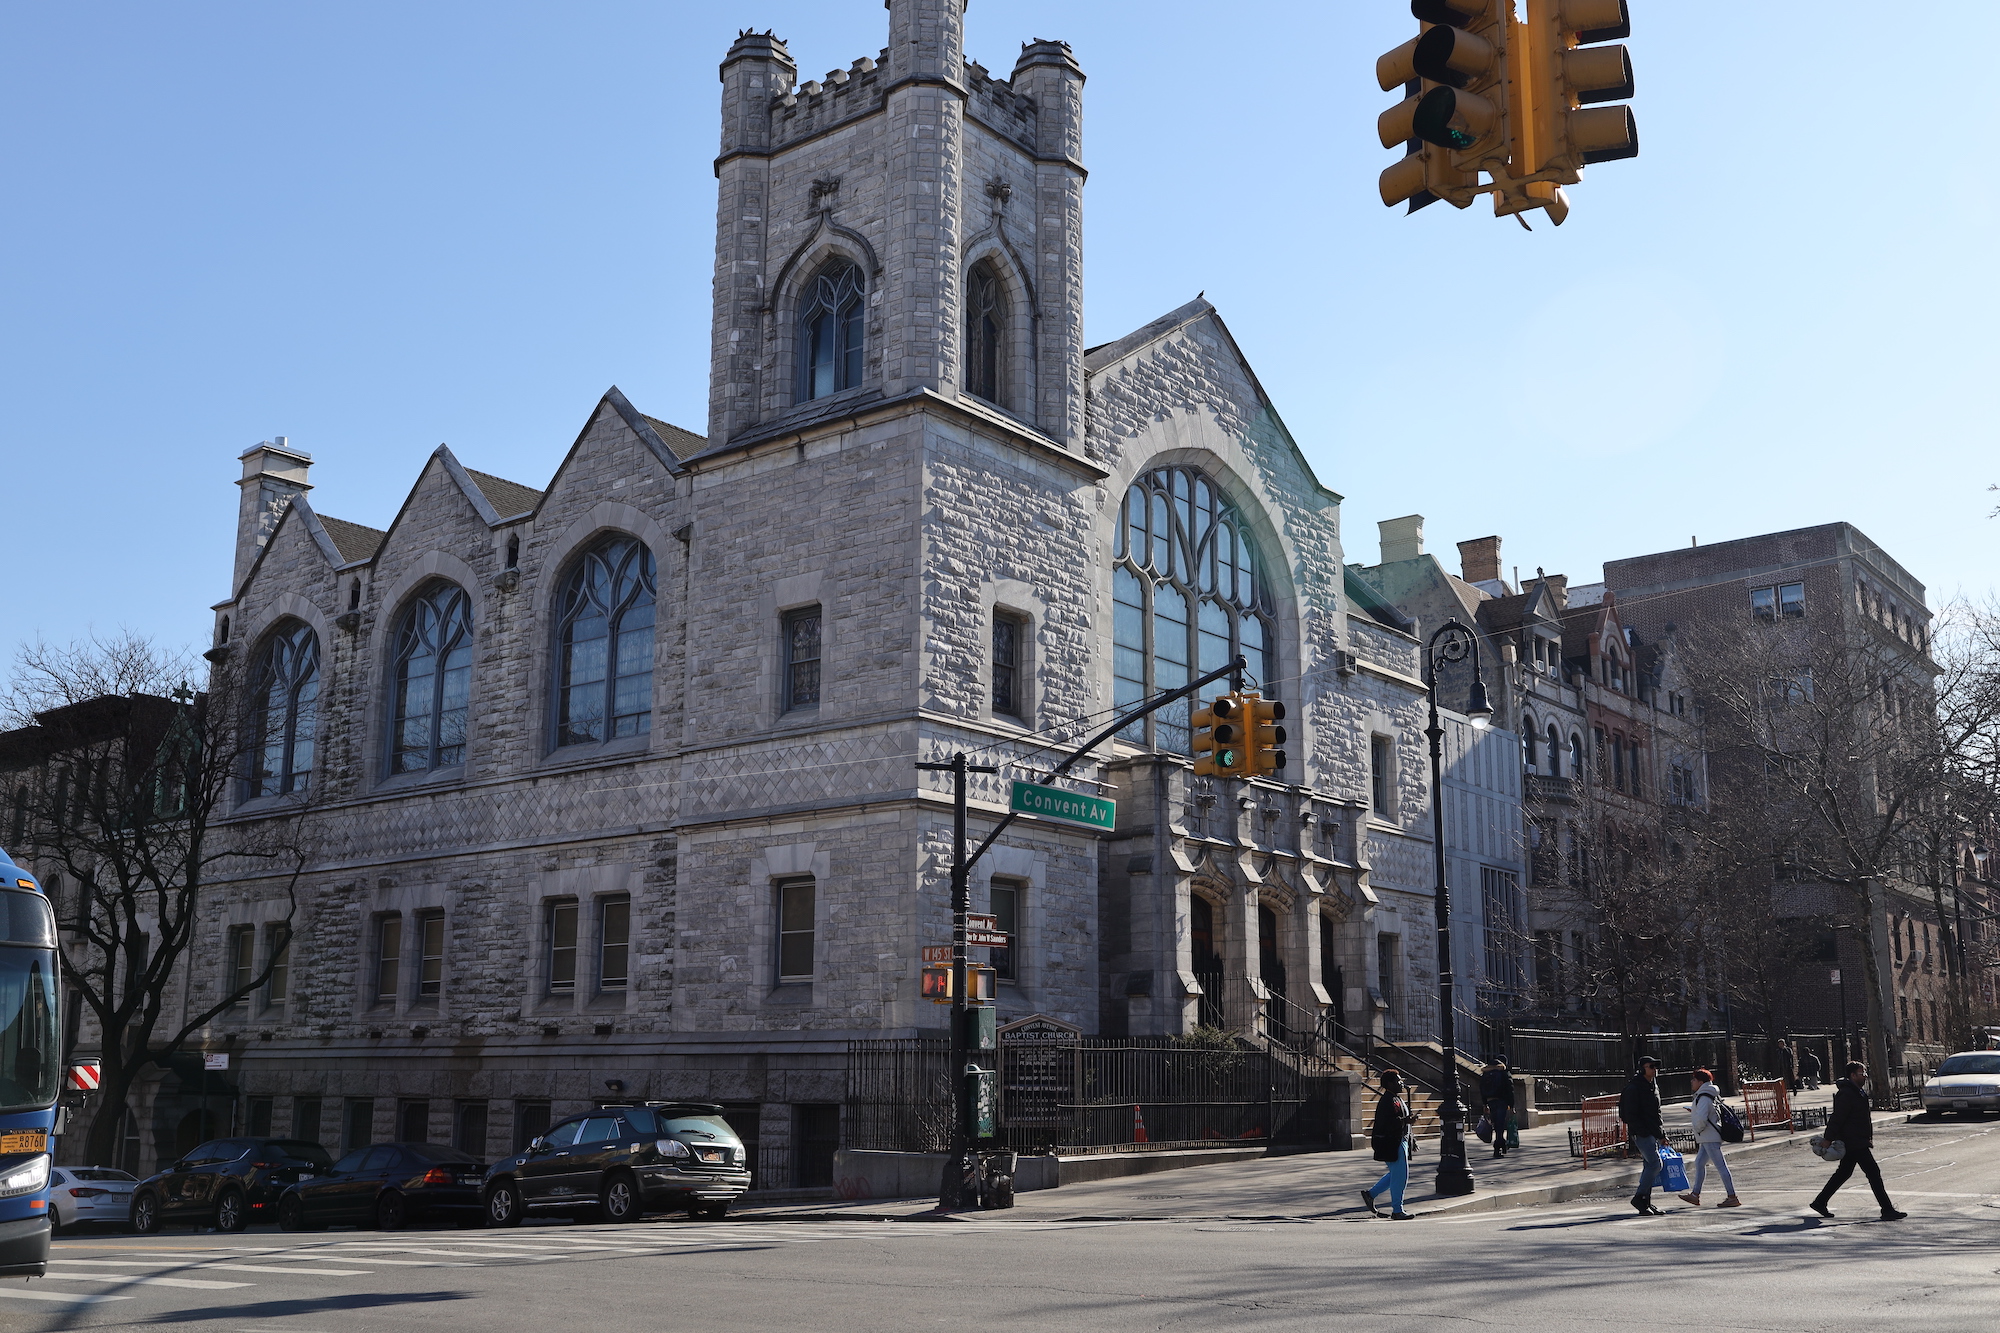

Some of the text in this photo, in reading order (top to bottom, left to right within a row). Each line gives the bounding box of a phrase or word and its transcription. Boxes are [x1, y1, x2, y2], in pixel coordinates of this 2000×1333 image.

[1023, 790, 1107, 821] Convent Av
[924, 947, 951, 961] W 145 ST
[1021, 1022, 1059, 1032] CONVENT AVENUE
[25, 1135, 44, 1148] 8760
